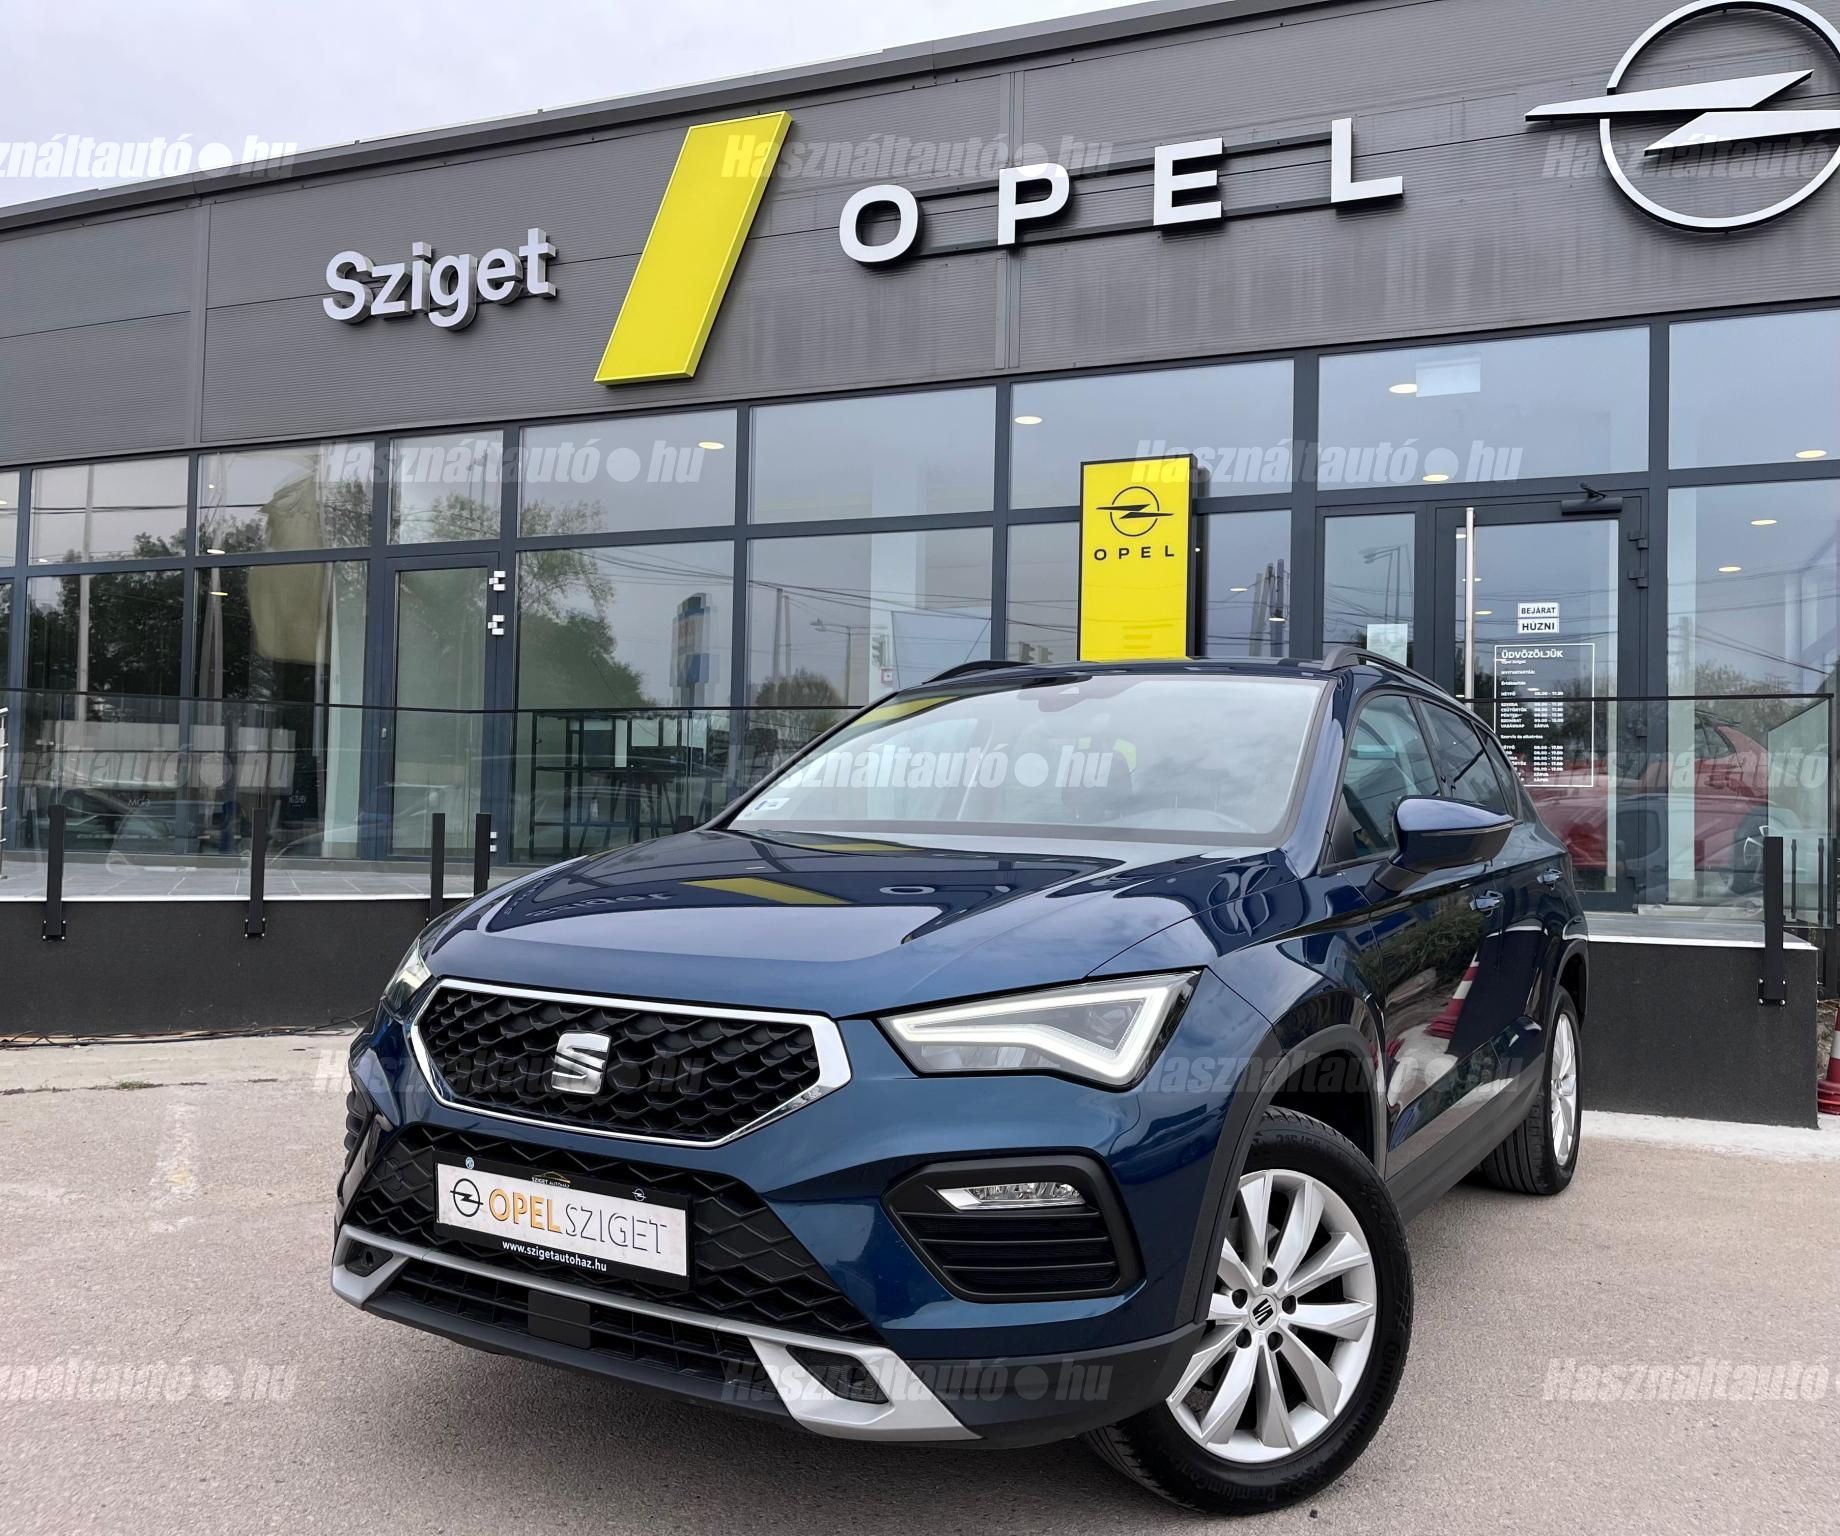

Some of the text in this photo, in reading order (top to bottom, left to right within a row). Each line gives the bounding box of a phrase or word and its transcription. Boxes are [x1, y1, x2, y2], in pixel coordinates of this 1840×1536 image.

[838, 117, 1404, 264] OPEL
[322, 227, 557, 331] Sziget
[1093, 545, 1175, 561] OPEL
[1521, 606, 1556, 615] BEJÁRAT
[1522, 620, 1555, 631] HÚZNI
[1501, 648, 1564, 659] ÜDVÖZÖLJÜK
[502, 1239, 608, 1272] www.szigetautohaz.hu
